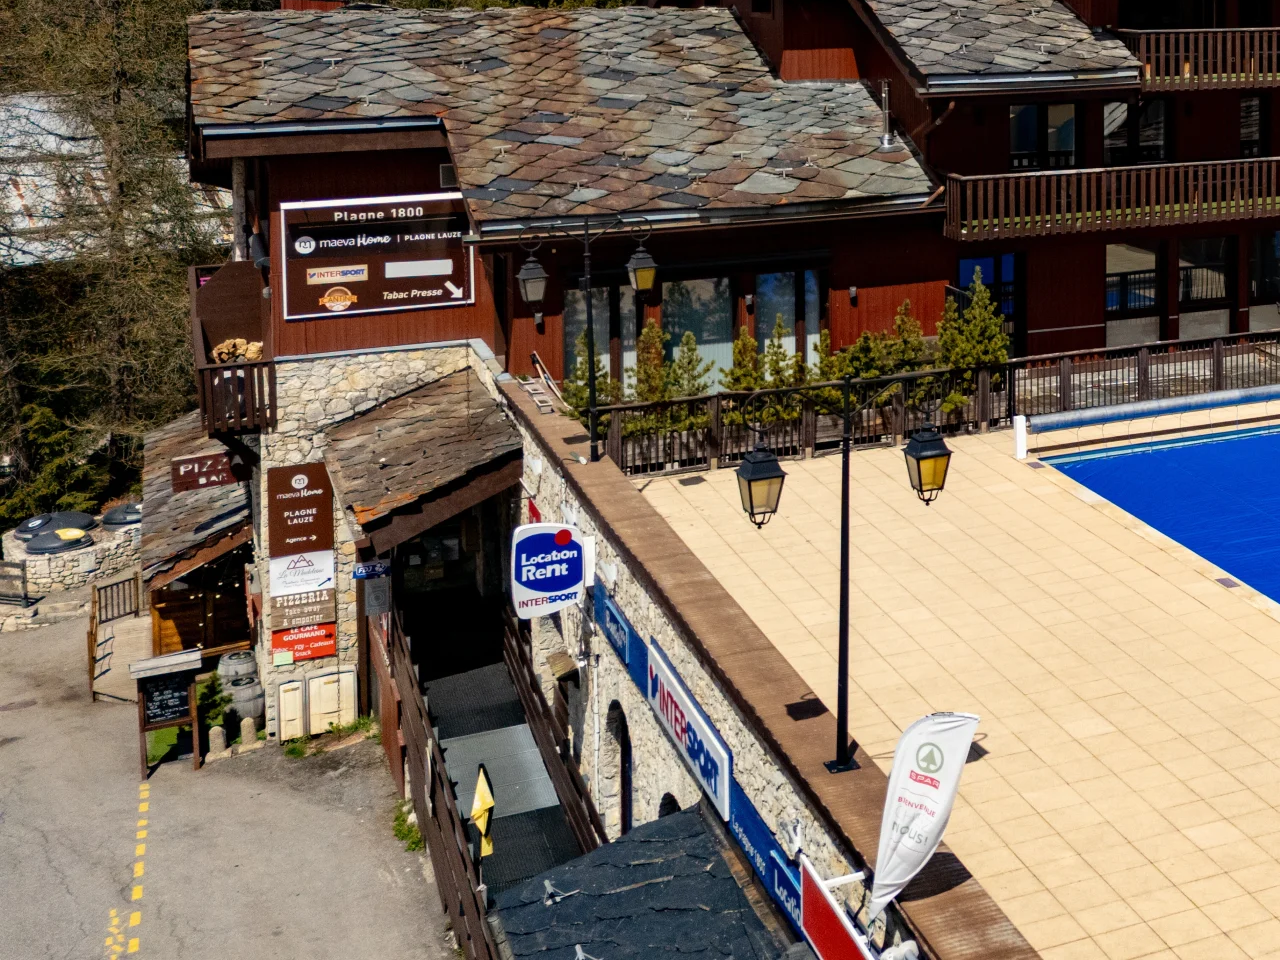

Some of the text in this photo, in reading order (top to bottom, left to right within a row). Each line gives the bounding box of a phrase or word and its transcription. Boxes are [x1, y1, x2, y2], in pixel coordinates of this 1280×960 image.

[334, 207, 424, 223] Plagne 1800
[320, 234, 392, 248] maeva Home
[404, 231, 462, 242] PLAGNE LAUZE
[316, 268, 365, 279] INTERSPORT
[382, 288, 443, 300] Tabac Presse
[276, 488, 324, 500] maeva Home
[283, 508, 317, 518] PLAGNE
[287, 516, 314, 525] LAUZE
[285, 536, 307, 544] Agence
[521, 549, 578, 566] Location
[521, 562, 569, 582] Rent
[276, 590, 329, 608] PIZZERIA
[518, 591, 578, 609] INTERSPORT
[284, 607, 301, 616] Take
[291, 614, 324, 625] emporter
[283, 629, 326, 642] GOURMAND
[309, 639, 335, 648] Cadeaux
[659, 678, 719, 800] INTERSPORT
[910, 771, 940, 788] SPAR
[897, 796, 937, 818] BIENVENUE
[774, 868, 801, 926] Locatio
